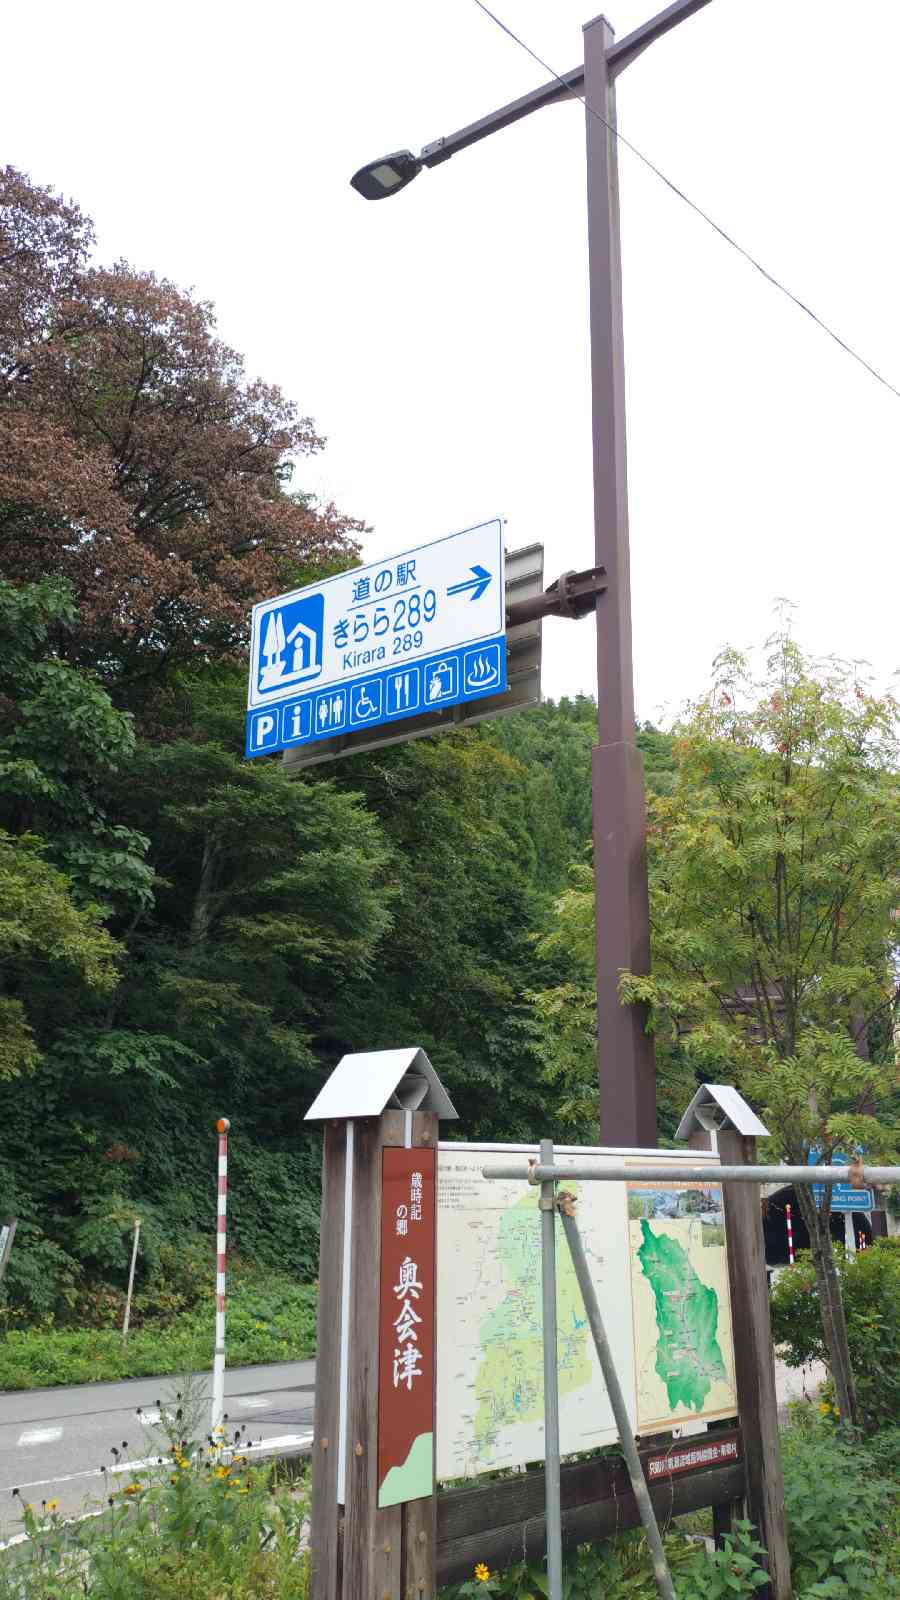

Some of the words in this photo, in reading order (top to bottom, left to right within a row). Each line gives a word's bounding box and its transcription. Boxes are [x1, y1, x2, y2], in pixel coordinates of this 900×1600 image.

[352, 560, 417, 603] 道の駅
[333, 589, 437, 649] きらら289
[343, 646, 386, 670] Kirara
[392, 630, 423, 655] 289
[256, 715, 274, 746] P
[410, 1171, 423, 1221] 歳時記
[396, 1204, 408, 1236] の郷
[392, 1256, 424, 1391] 奥会津
